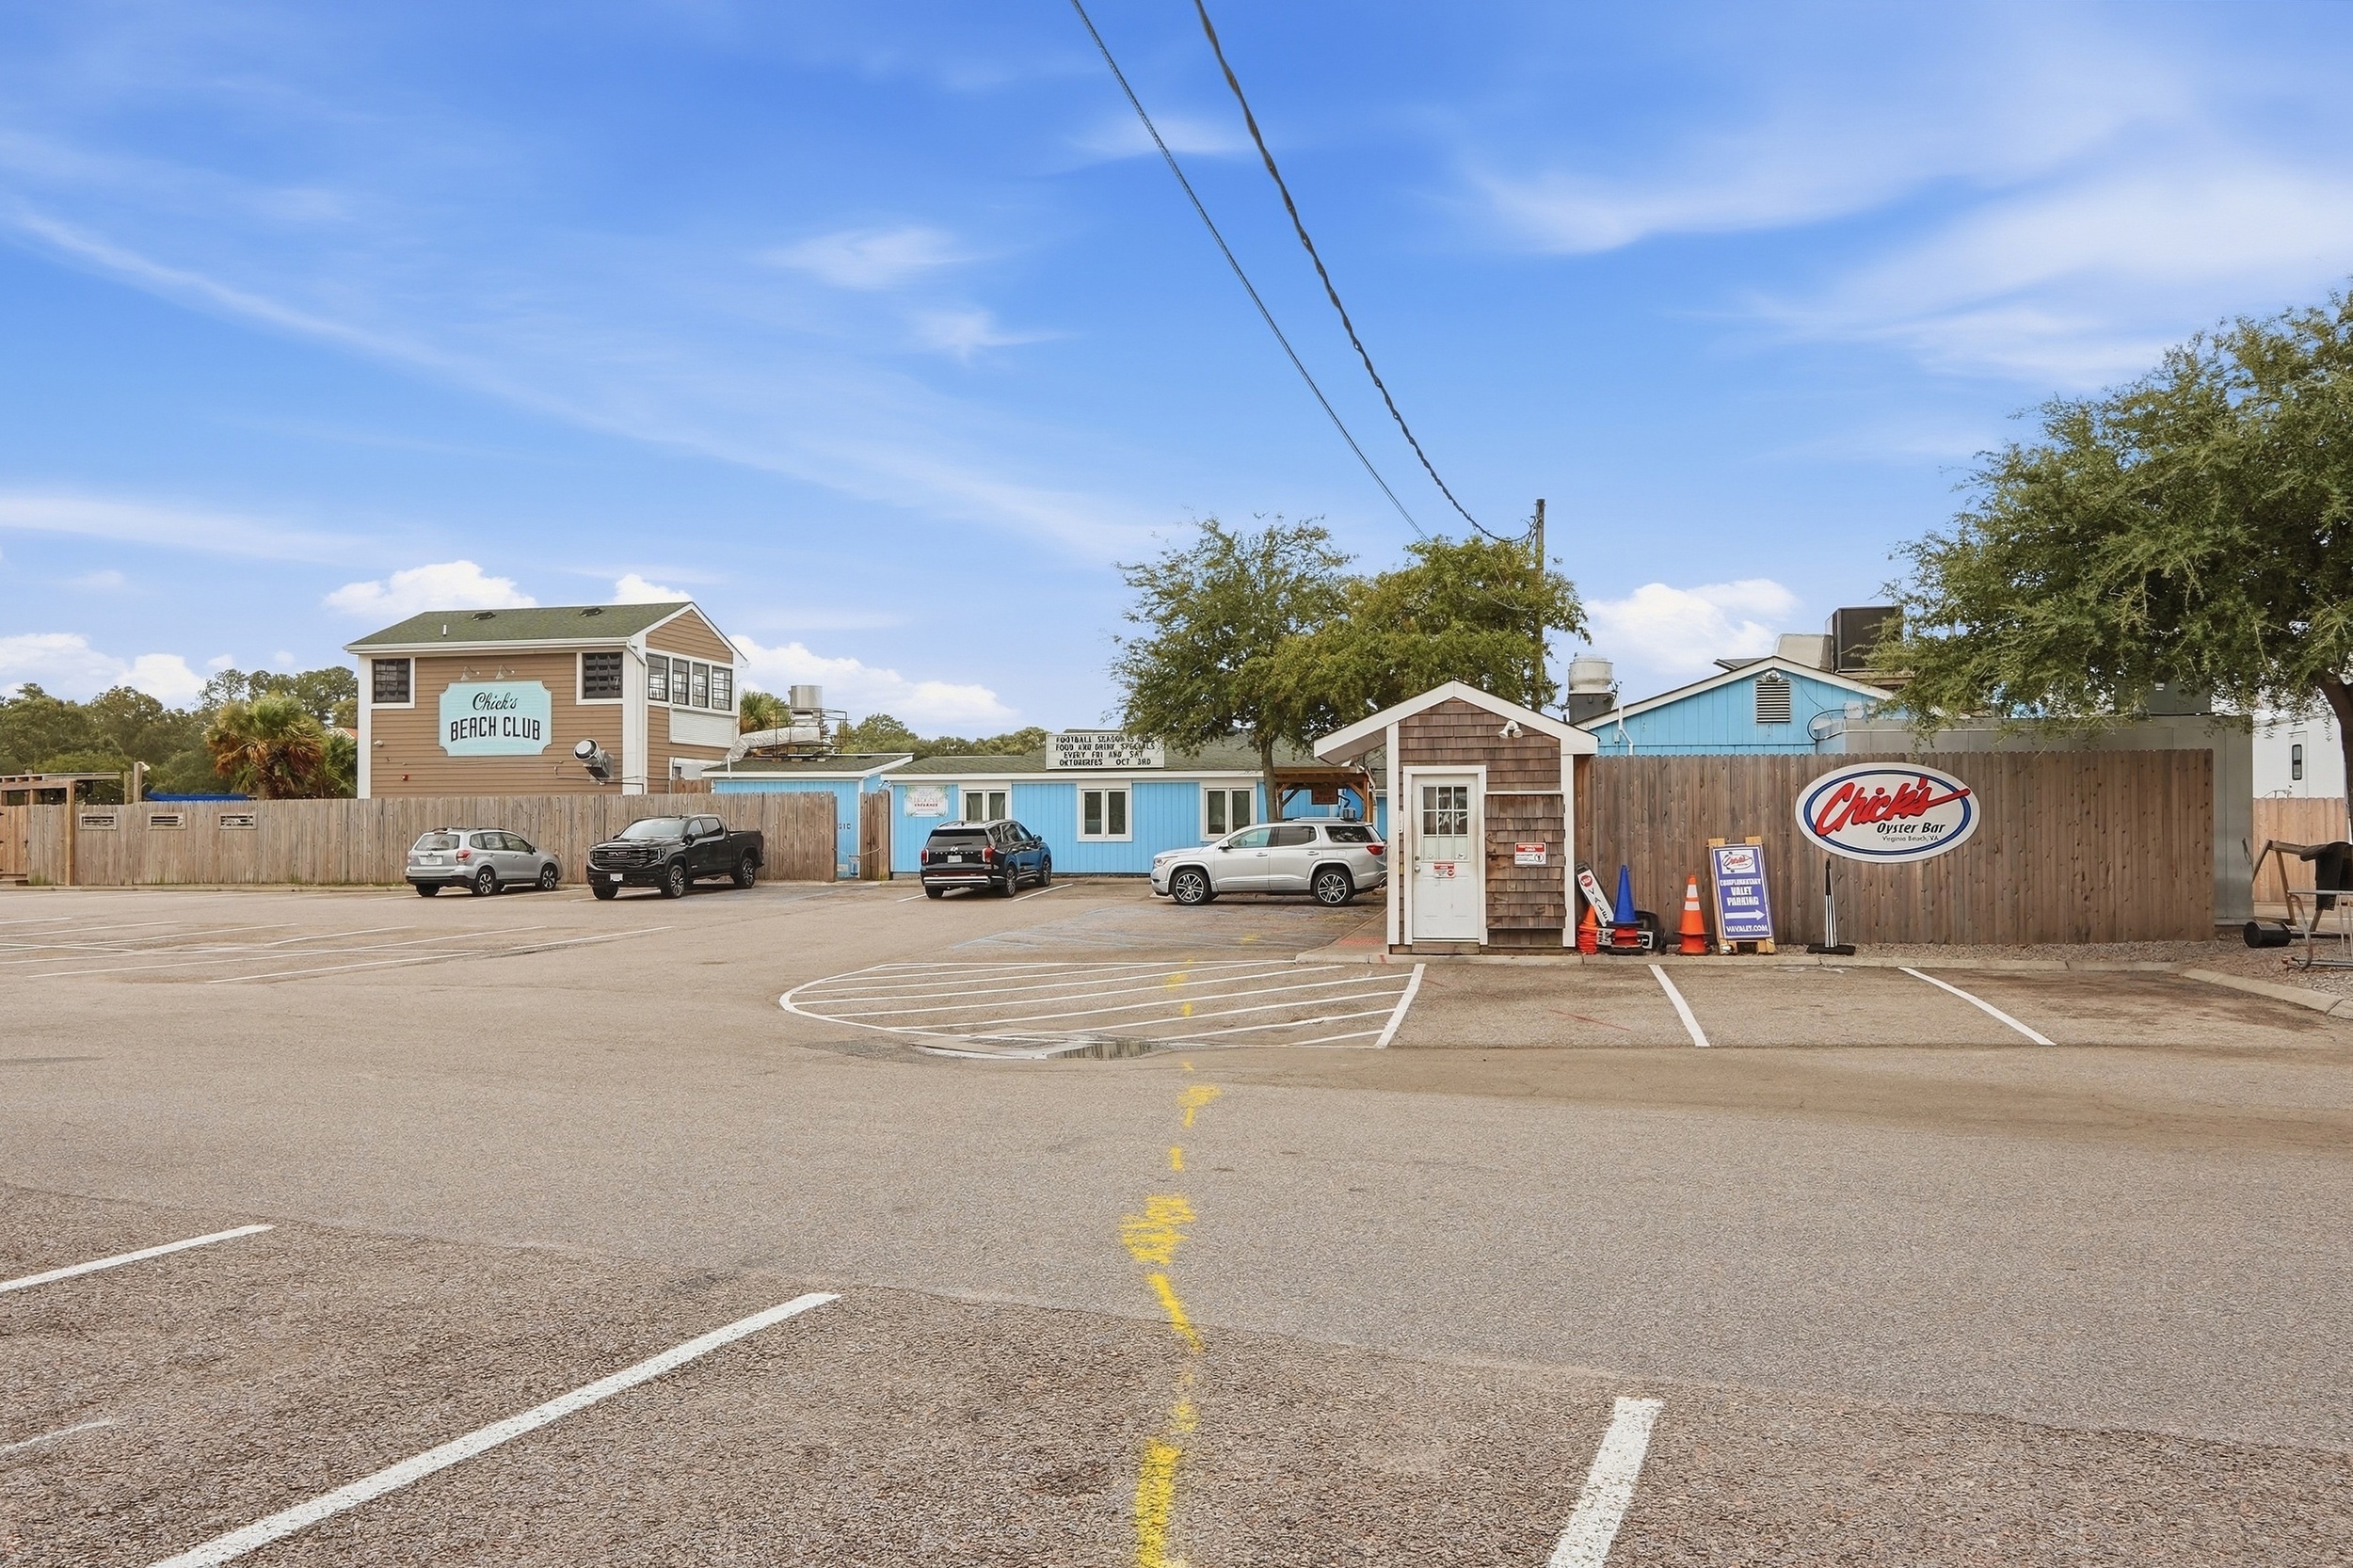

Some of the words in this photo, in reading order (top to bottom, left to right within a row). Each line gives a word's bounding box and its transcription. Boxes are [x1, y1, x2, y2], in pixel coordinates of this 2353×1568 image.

[472, 692, 518, 711] Chick's
[451, 716, 496, 742] BEACH
[504, 716, 540, 741] CLUB
[1137, 758, 1151, 766] 3RD
[1815, 777, 1971, 837] Chick's
[1876, 822, 1919, 835] Oyster
[1921, 822, 1946, 834] Bar
[1882, 835, 1907, 843] Virginia
[1730, 887, 1753, 896] VALET
[1726, 896, 1760, 906] PARKING
